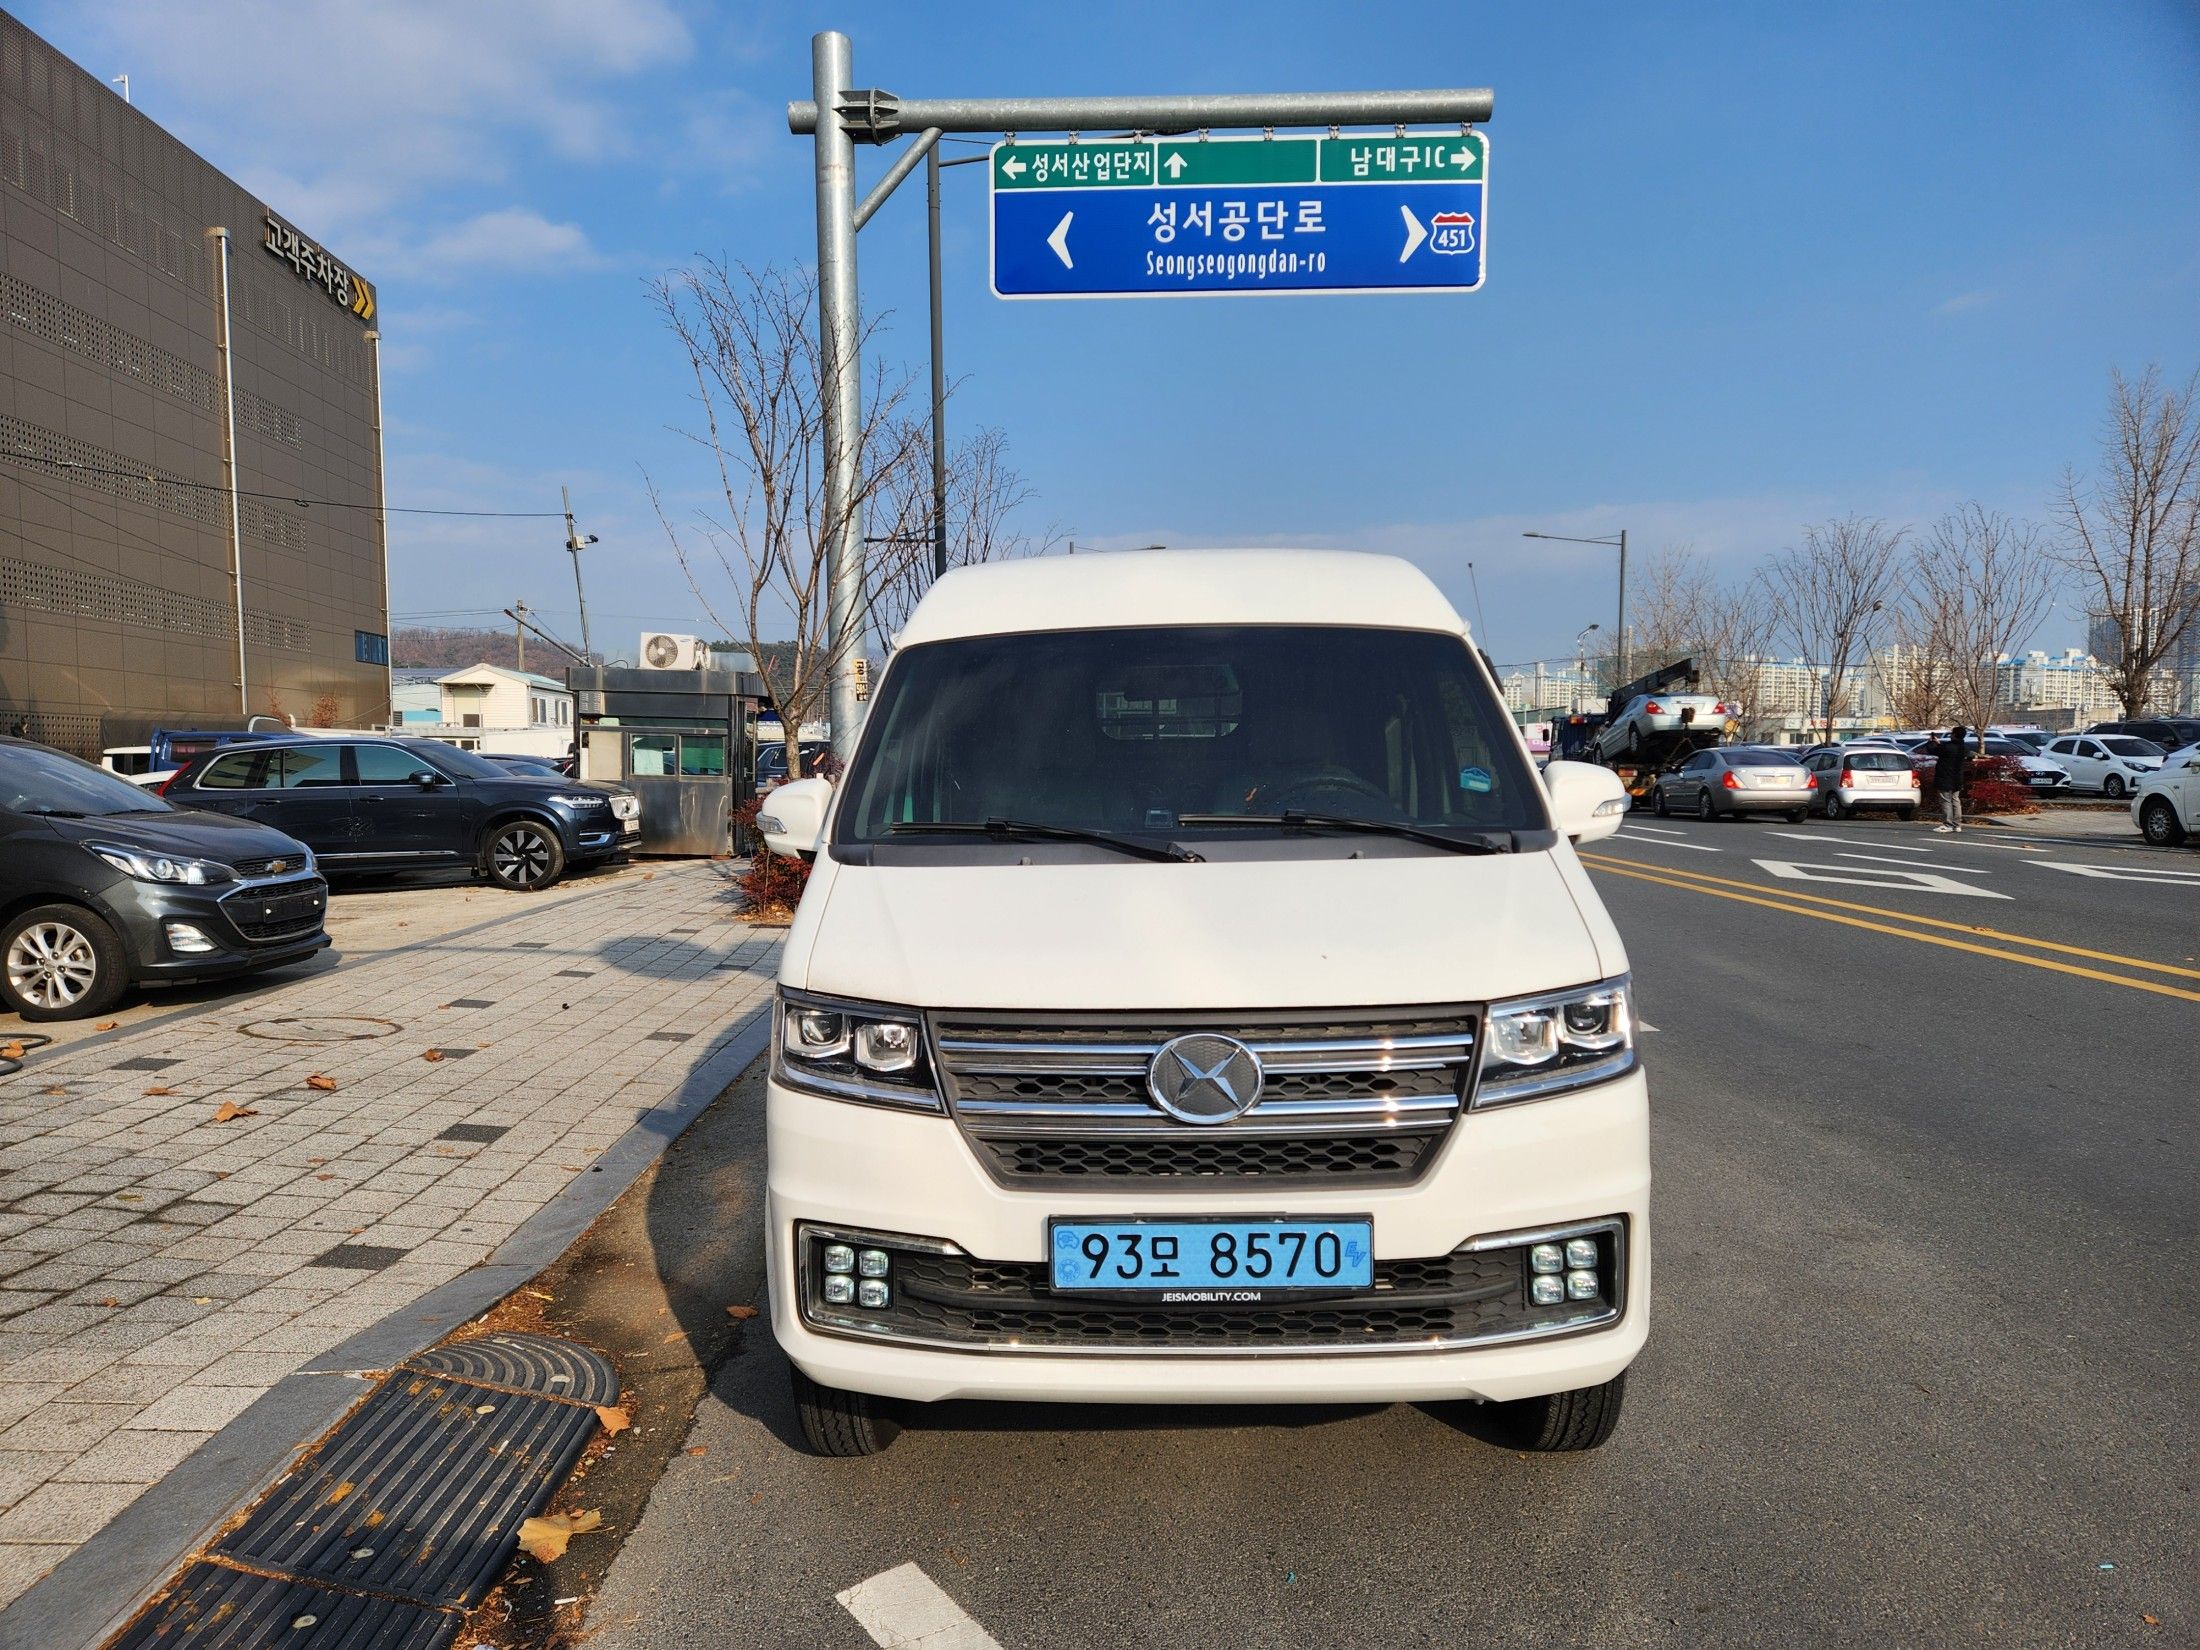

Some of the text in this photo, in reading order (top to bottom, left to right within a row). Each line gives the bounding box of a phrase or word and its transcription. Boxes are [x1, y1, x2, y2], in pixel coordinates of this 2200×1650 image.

[1032, 151, 1150, 181] 성서산업단지
[1351, 145, 1445, 176] 남대구IC
[1146, 200, 1326, 243] 성서공단로
[1438, 227, 1467, 248] 451
[265, 217, 349, 307] 고객주차장
[1147, 249, 1326, 280] Seongseogongdan-ro
[1081, 1232, 1341, 1279] 93모 8570
[1161, 1292, 1261, 1302] JEISMOBILITY.COM
